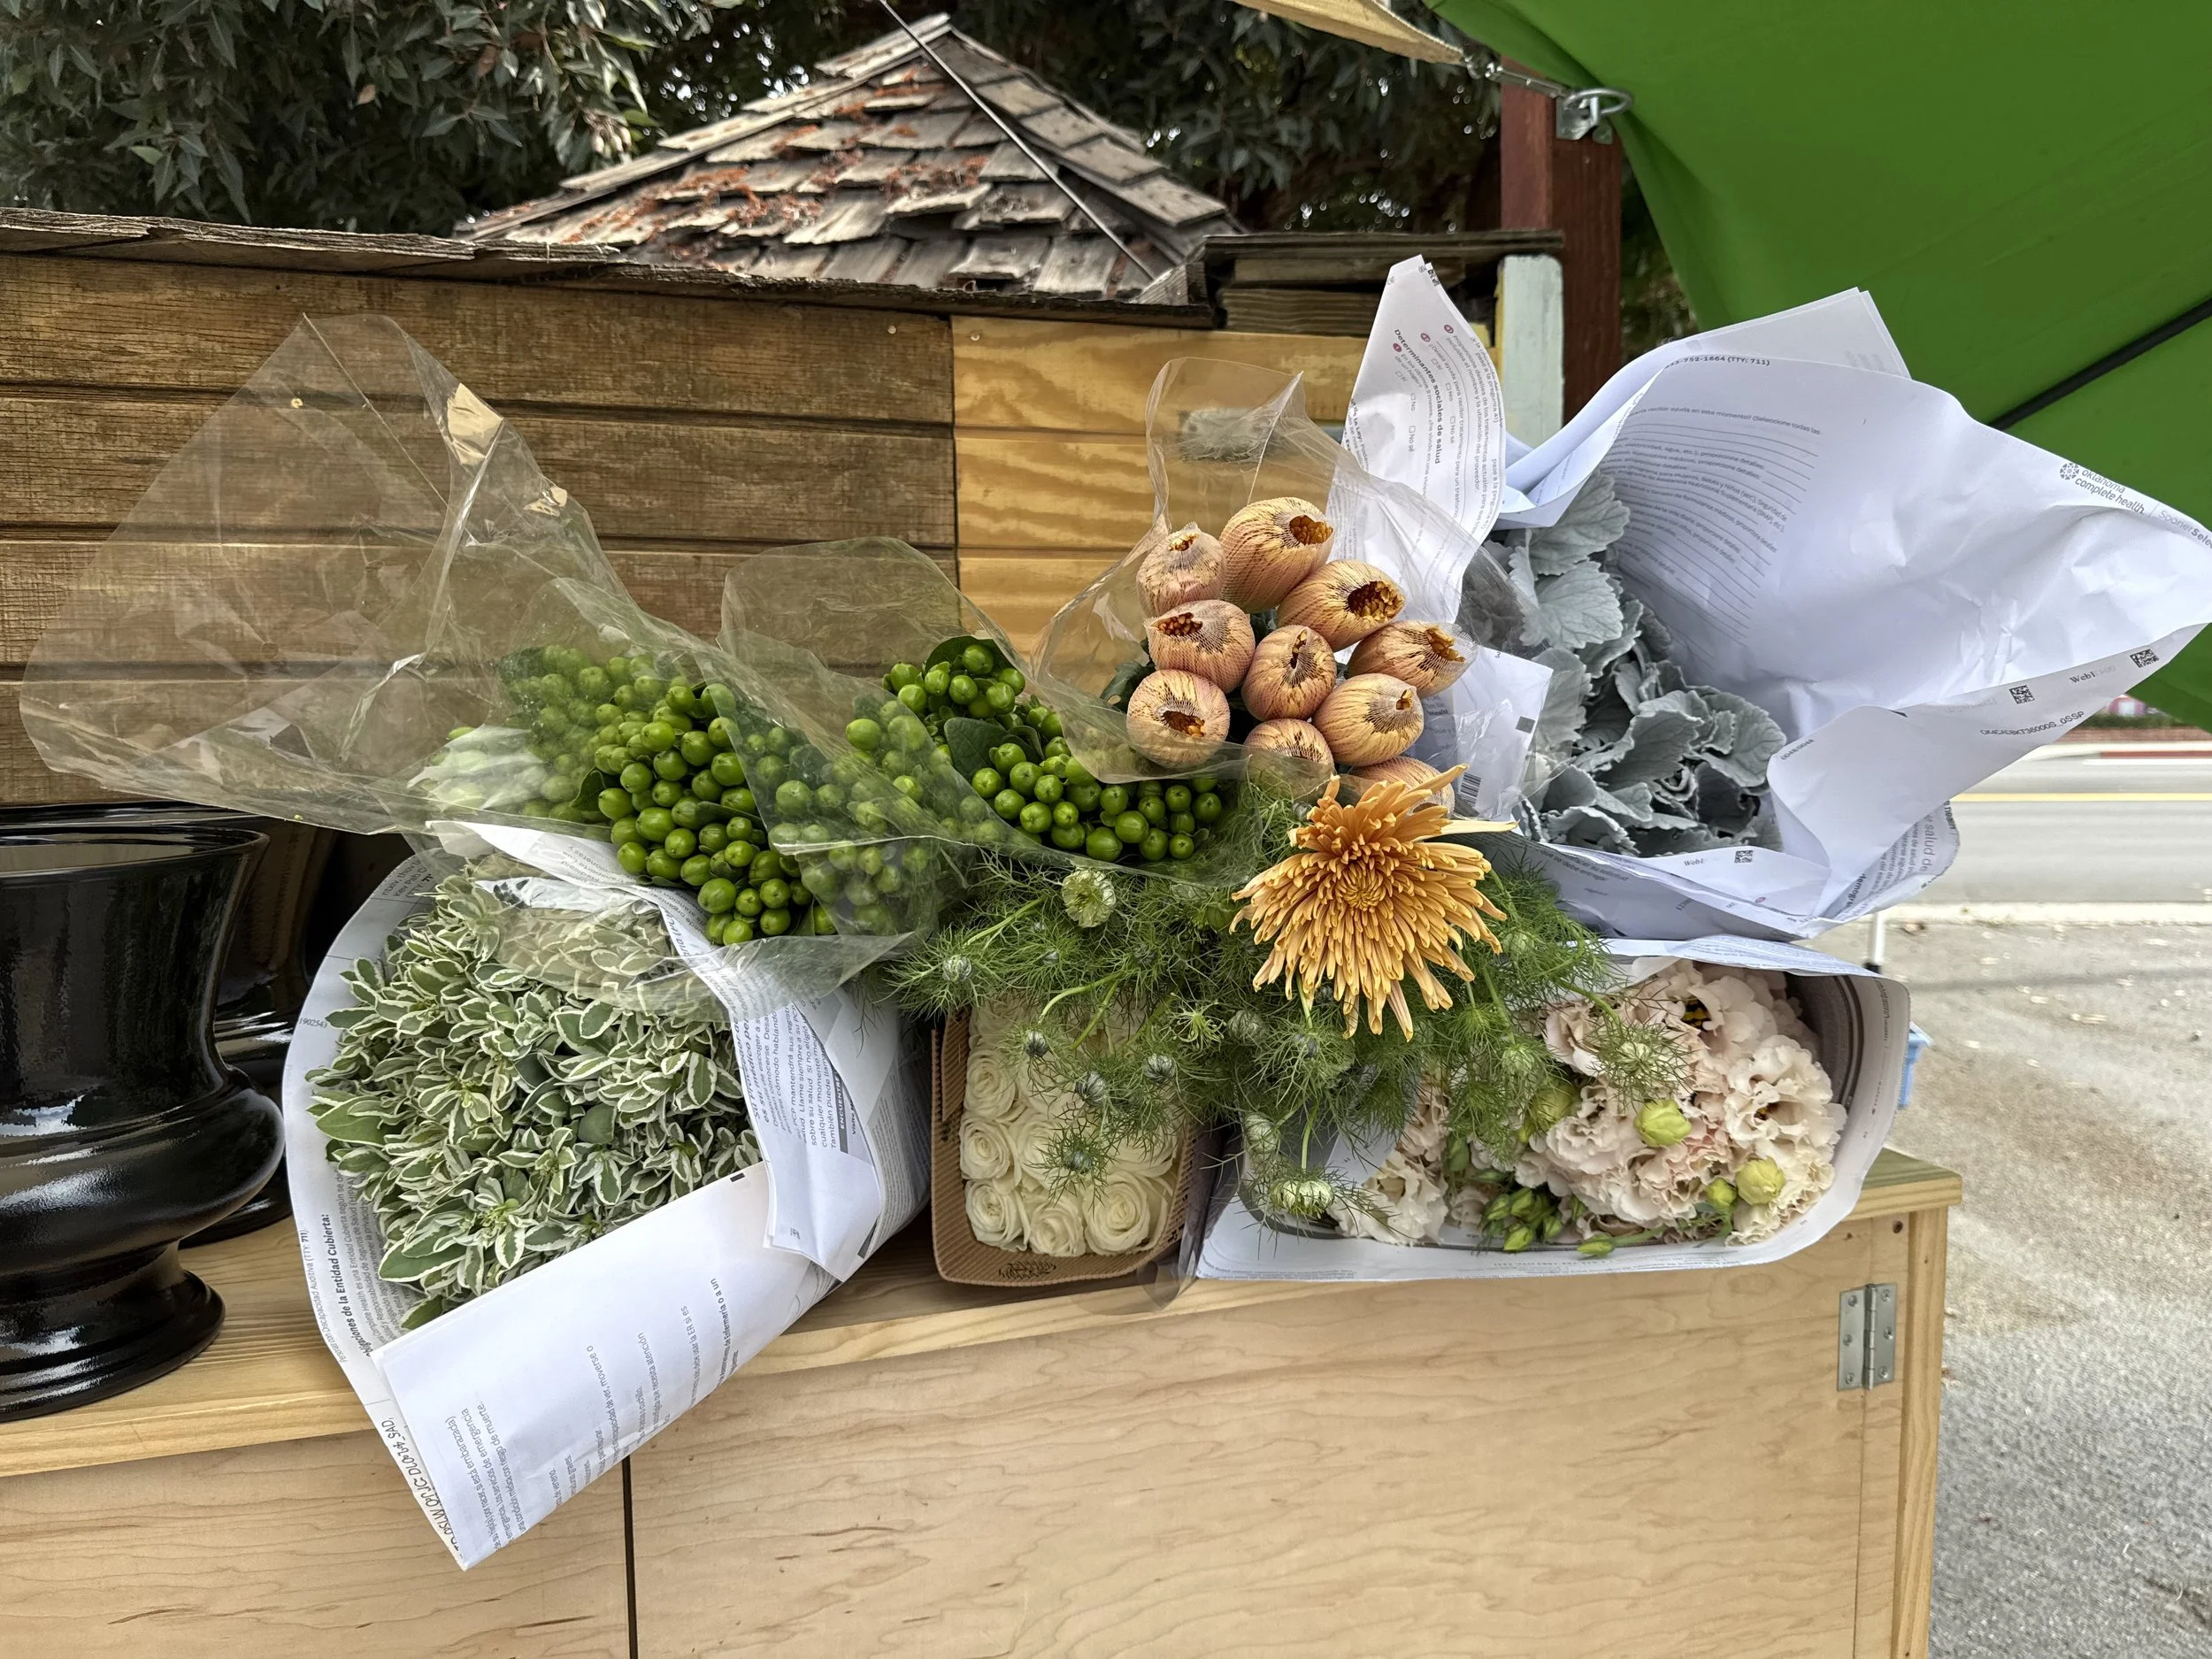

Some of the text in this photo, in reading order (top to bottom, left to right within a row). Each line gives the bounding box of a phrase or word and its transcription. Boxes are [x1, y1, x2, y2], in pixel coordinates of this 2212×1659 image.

[1394, 327, 1436, 384] Determinantes
[1446, 336, 1465, 362] incluidos
[1467, 368, 1479, 394] nombre
[1750, 357, 1770, 366] 711)
[1443, 361, 1456, 380] ayuda
[1453, 334, 1478, 369] Proporcione
[1474, 369, 1486, 396] detalles
[1482, 396, 1487, 405] de
[1452, 380, 1461, 396] para
[1486, 380, 1498, 411] pregunta
[1432, 384, 1443, 422] sociales
[1409, 401, 1416, 443] No No
[1436, 425, 1443, 436] de
[1449, 425, 1455, 434] No
[1752, 414, 1791, 427] (Seleccione
[1791, 422, 1810, 433] todas
[1455, 477, 1459, 486] un
[2073, 474, 2147, 515] complete health
[2158, 509, 2211, 546] SoonerSele
[1918, 825, 1933, 873] salud de
[560, 859, 599, 883] Medicaid
[1561, 859, 1579, 872] debe
[648, 890, 687, 918] organizar
[663, 888, 697, 918] atención
[795, 1023, 801, 1034] su
[730, 985, 770, 1123] es su médico personal
[753, 1033, 764, 1071] escoger
[769, 1011, 783, 1096] cómodo hablando
[795, 1043, 805, 1081] siempre
[731, 1016, 761, 1119] Su de
[758, 1072, 767, 1086] de
[786, 1053, 797, 1105] mantendrá
[796, 1083, 805, 1112] Llame
[800, 1025, 818, 1146] sobre su Si no eligió
[789, 1106, 799, 1125] PCP
[813, 1056, 829, 1148] cualquier momento
[824, 1078, 838, 1148] También puede
[834, 1075, 846, 1129] ENCUENTRE
[336, 1193, 346, 1214] según
[320, 1213, 336, 1256] Cubierta:
[339, 1215, 350, 1242] Cubierta
[343, 1243, 356, 1269] Entidad
[349, 1206, 384, 1321] Responsabilidad de Seguros de Salud
[305, 1263, 318, 1290] Auditiva
[327, 1256, 345, 1294] Entidad
[355, 1281, 361, 1290] es
[709, 1277, 719, 1289] un
[311, 1289, 330, 1333] Discapacidad
[337, 1294, 348, 1304] la
[341, 1304, 351, 1317] de
[357, 1290, 368, 1311] Health
[375, 1281, 398, 1326] obligación legal
[680, 1304, 688, 1316] es
[686, 1324, 695, 1334] ER
[717, 1303, 731, 1339] Enfermería
[325, 1332, 334, 1343] con
[635, 1331, 655, 1365] atención
[688, 1333, 697, 1342] la
[330, 1340, 346, 1363] Personas
[588, 1351, 608, 1386] moverse
[648, 1364, 659, 1389] necesita
[601, 1386, 611, 1400] ver,
[604, 1399, 613, 1408] de
[475, 1401, 494, 1434] muerte.
[444, 1415, 475, 1469] embarazada)
[488, 1433, 500, 1446] de
[458, 1407, 503, 1504] Los servicios de emergencia
[495, 1445, 508, 1465] riesgo
[562, 1453, 575, 1475] graves.
[467, 1468, 480, 1485] está
[503, 1475, 516, 1496] médica
[483, 1506, 492, 1517] por
[510, 1495, 523, 1522] condición
[484, 1515, 498, 1534] hijo(a)
